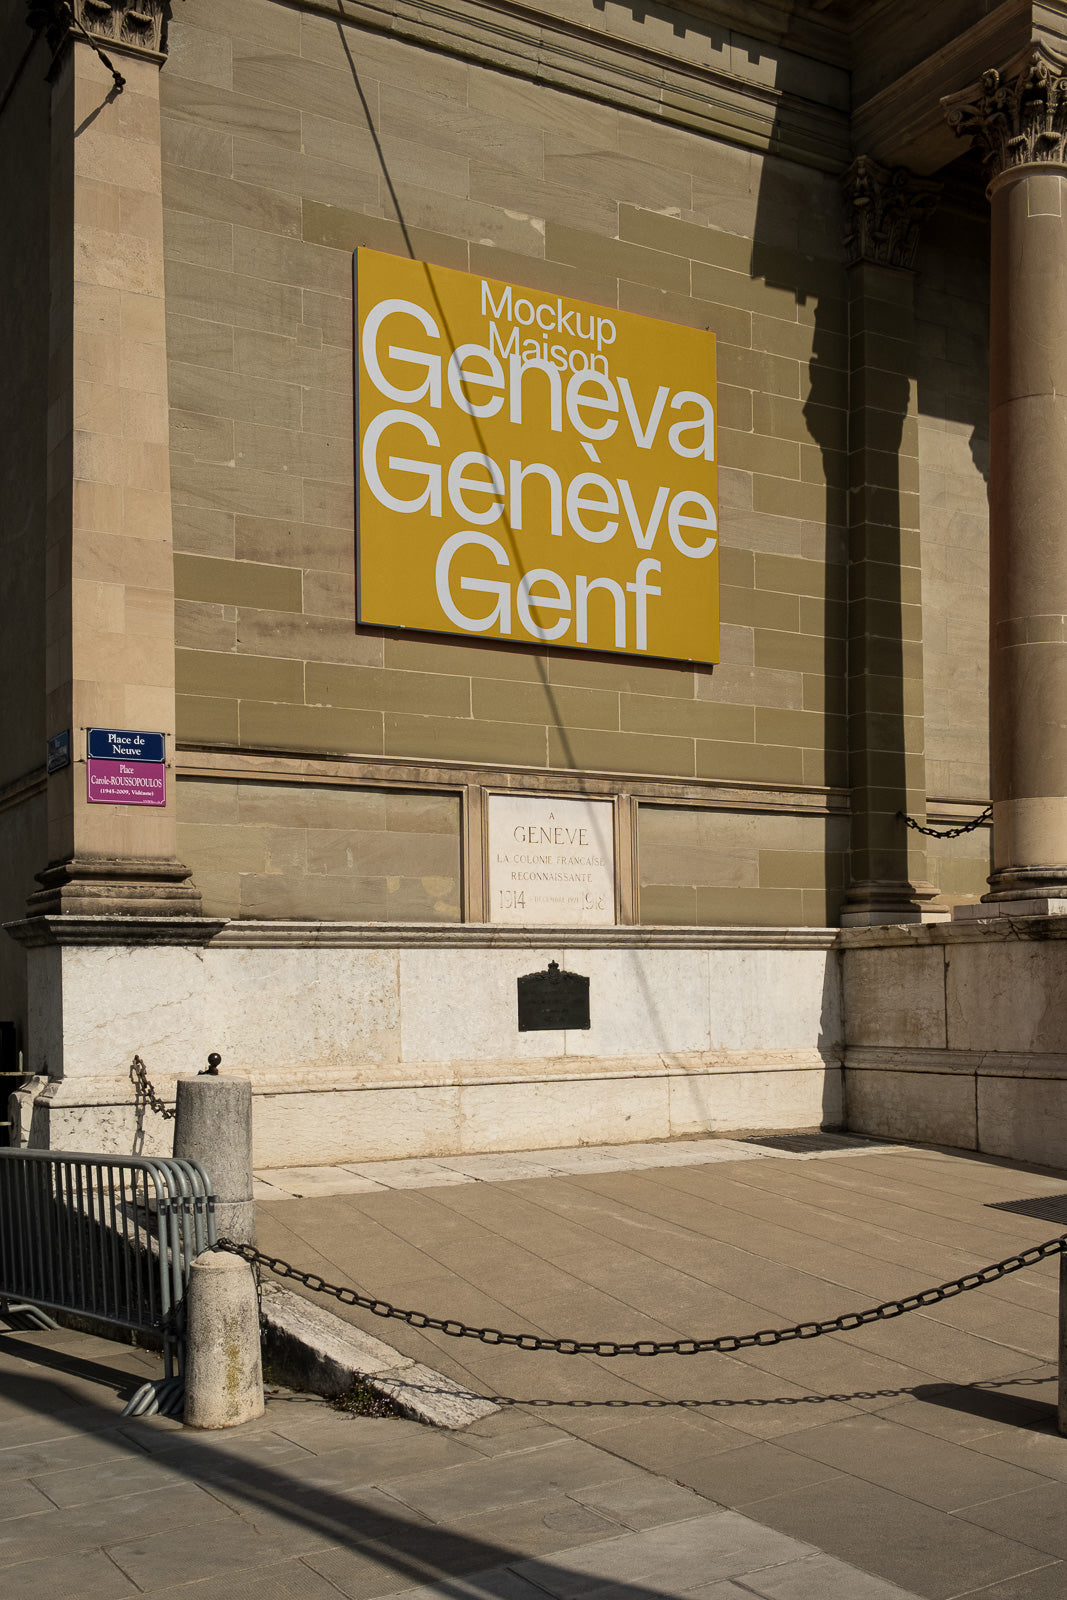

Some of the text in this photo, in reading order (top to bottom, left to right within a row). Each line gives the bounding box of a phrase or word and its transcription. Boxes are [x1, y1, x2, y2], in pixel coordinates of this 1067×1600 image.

[481, 280, 616, 351] Mockup
[489, 320, 609, 379] Maison
[362, 298, 715, 462] Geneva
[362, 409, 717, 559] Genève
[435, 530, 662, 650] Genf
[108, 733, 146, 745] Place de
[112, 744, 142, 755] Neuve
[119, 764, 134, 774] Place
[91, 775, 163, 788] Carole-ROUSSOPOULOS
[513, 825, 589, 846] GENEVE
[496, 853, 509, 863] LA
[513, 854, 552, 865] COLONIE
[511, 871, 593, 883] RECONNAISSANTE
[499, 890, 526, 909] 1914
